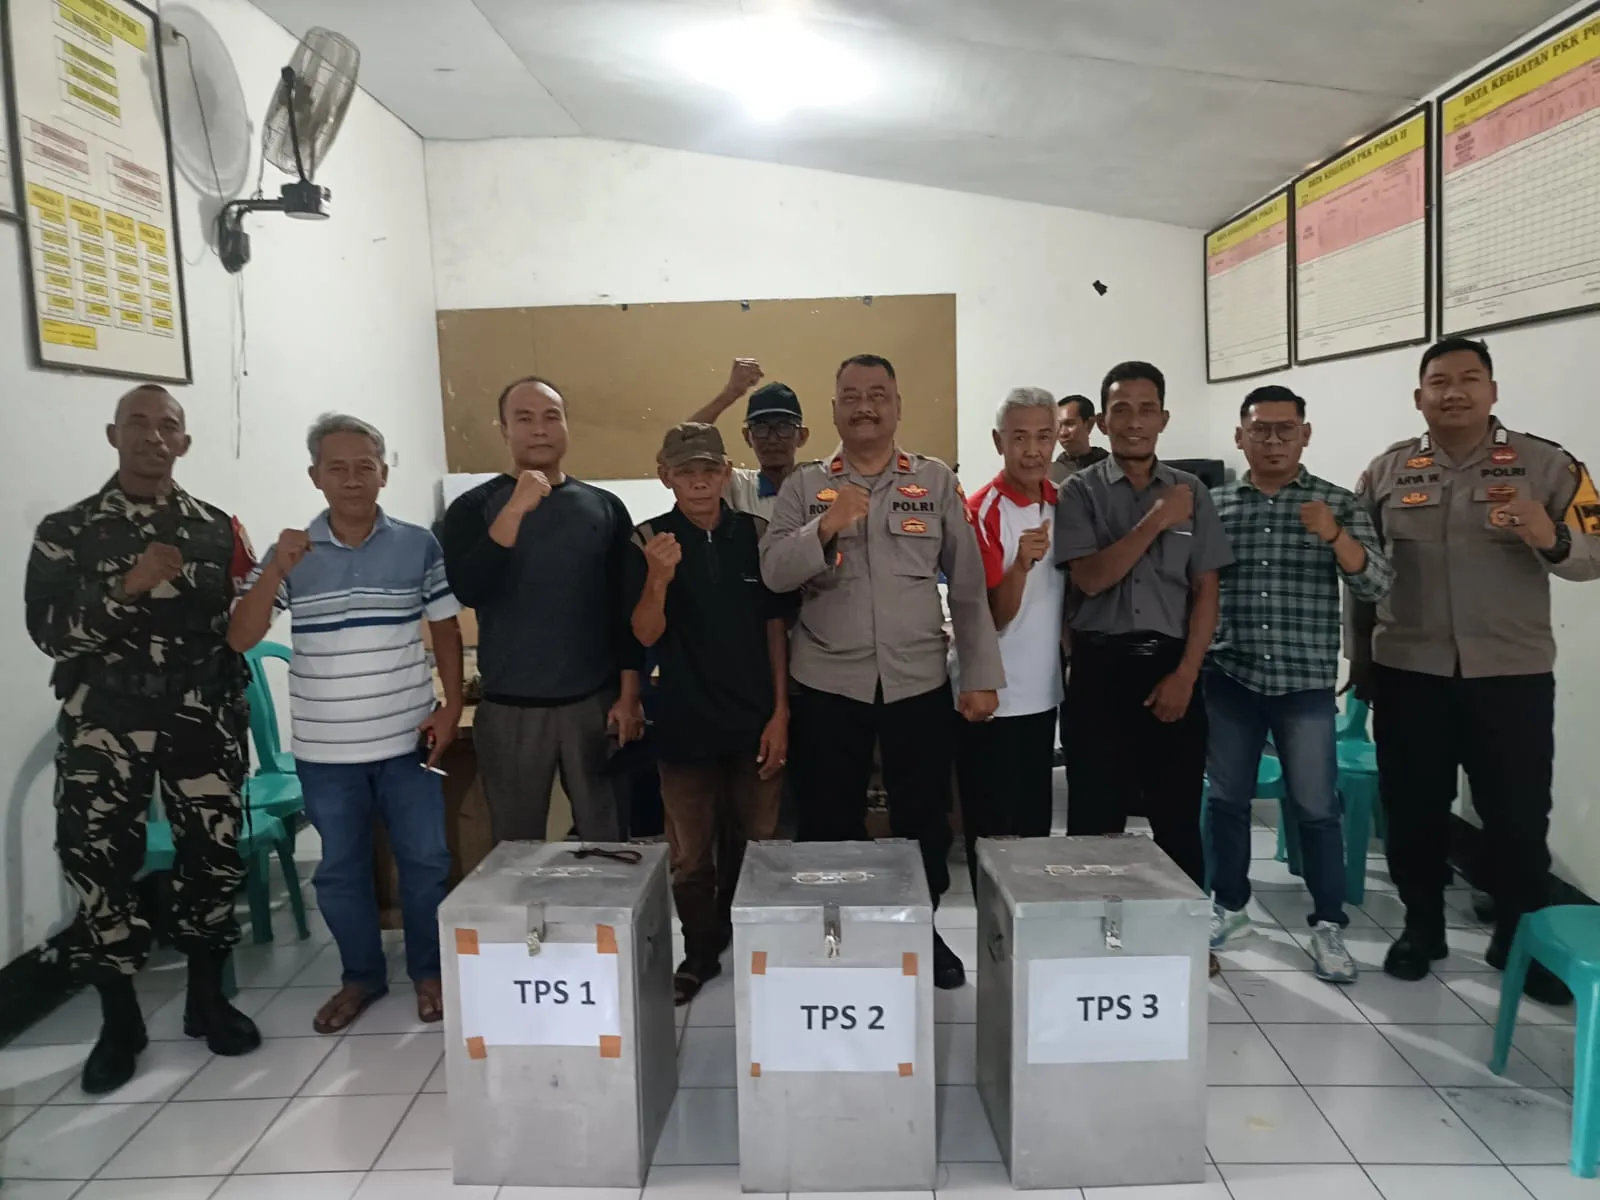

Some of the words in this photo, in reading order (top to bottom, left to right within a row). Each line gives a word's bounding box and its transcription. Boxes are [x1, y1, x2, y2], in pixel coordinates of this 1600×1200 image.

[1464, 83, 1489, 107] DATA
[1491, 50, 1549, 91] KEGIATAN
[1552, 33, 1579, 57] PKK
[1396, 474, 1424, 486] ARYA
[1481, 468, 1526, 478] POLRI
[892, 501, 934, 512] POLRI
[514, 980, 569, 1005] TPS
[580, 980, 596, 1005] 1
[800, 1005, 857, 1030] TPS
[868, 1005, 885, 1030] 2
[1077, 995, 1132, 1021] TPS
[1142, 993, 1159, 1019] 3
